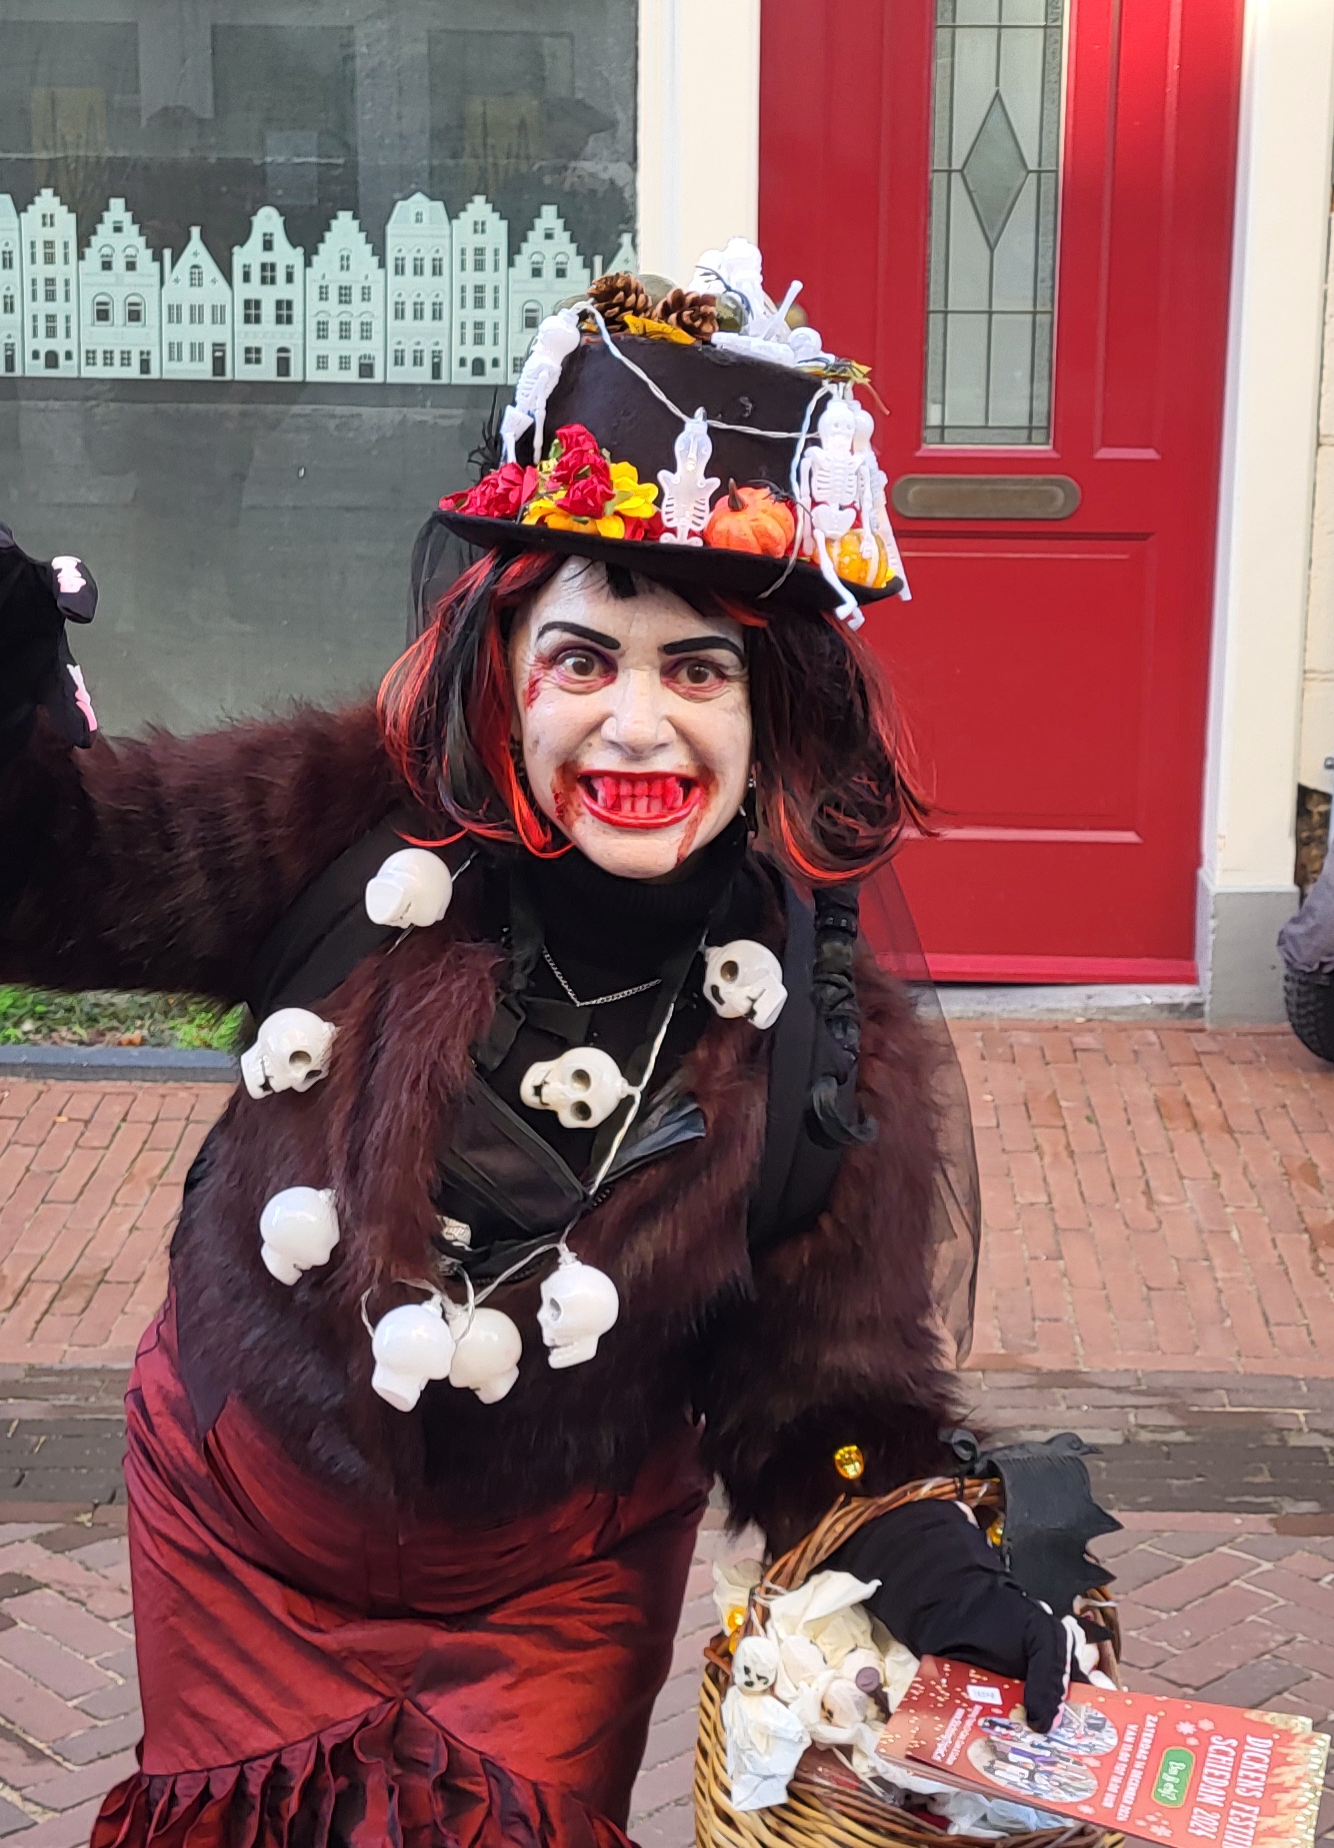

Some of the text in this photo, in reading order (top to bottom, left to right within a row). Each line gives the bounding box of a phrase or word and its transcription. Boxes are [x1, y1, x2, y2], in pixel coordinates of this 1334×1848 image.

[1123, 1723, 1139, 1743] VAN
[1135, 1713, 1158, 1760] ZATERDAG
[1187, 1734, 1239, 1840] SCHIEDAM 2024
[1235, 1734, 1274, 1799] DICKENS
